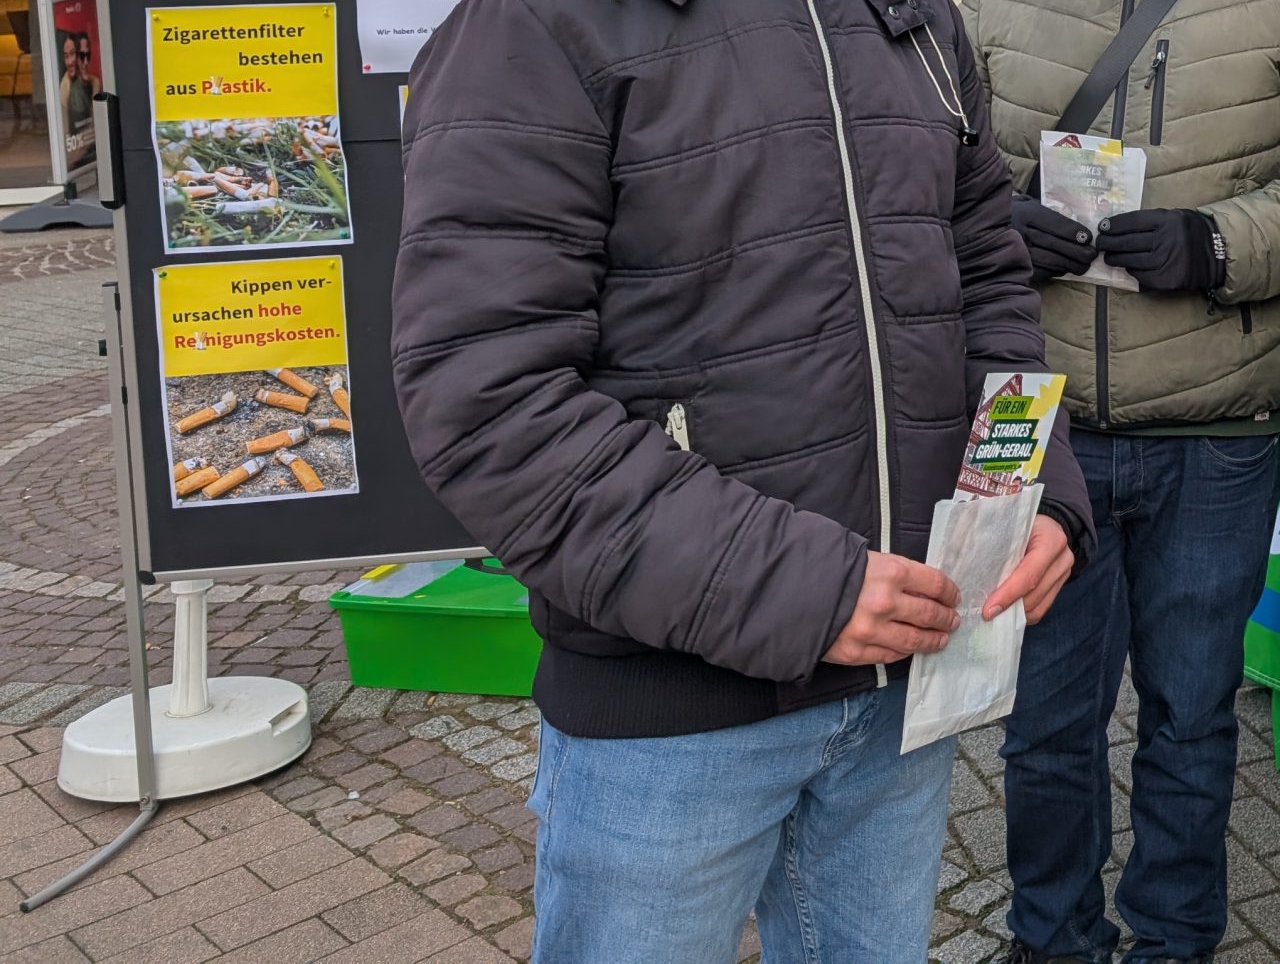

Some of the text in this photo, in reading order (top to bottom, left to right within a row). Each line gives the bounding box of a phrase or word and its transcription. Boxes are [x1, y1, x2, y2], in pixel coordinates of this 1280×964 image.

[162, 24, 305, 45] Zigarettenfilter
[376, 28, 391, 36] Wir
[393, 27, 415, 35] haben
[238, 50, 323, 66] bestehen
[166, 78, 272, 96] aus Pastik.
[231, 277, 332, 296] Kippen ver-
[172, 303, 302, 323] ursachen hohe
[174, 327, 340, 349] Renigungskosten.
[992, 397, 1027, 414] FÜR EIN
[992, 423, 1032, 438] STARKES
[976, 441, 1033, 459] GRÜN-GERAU.
